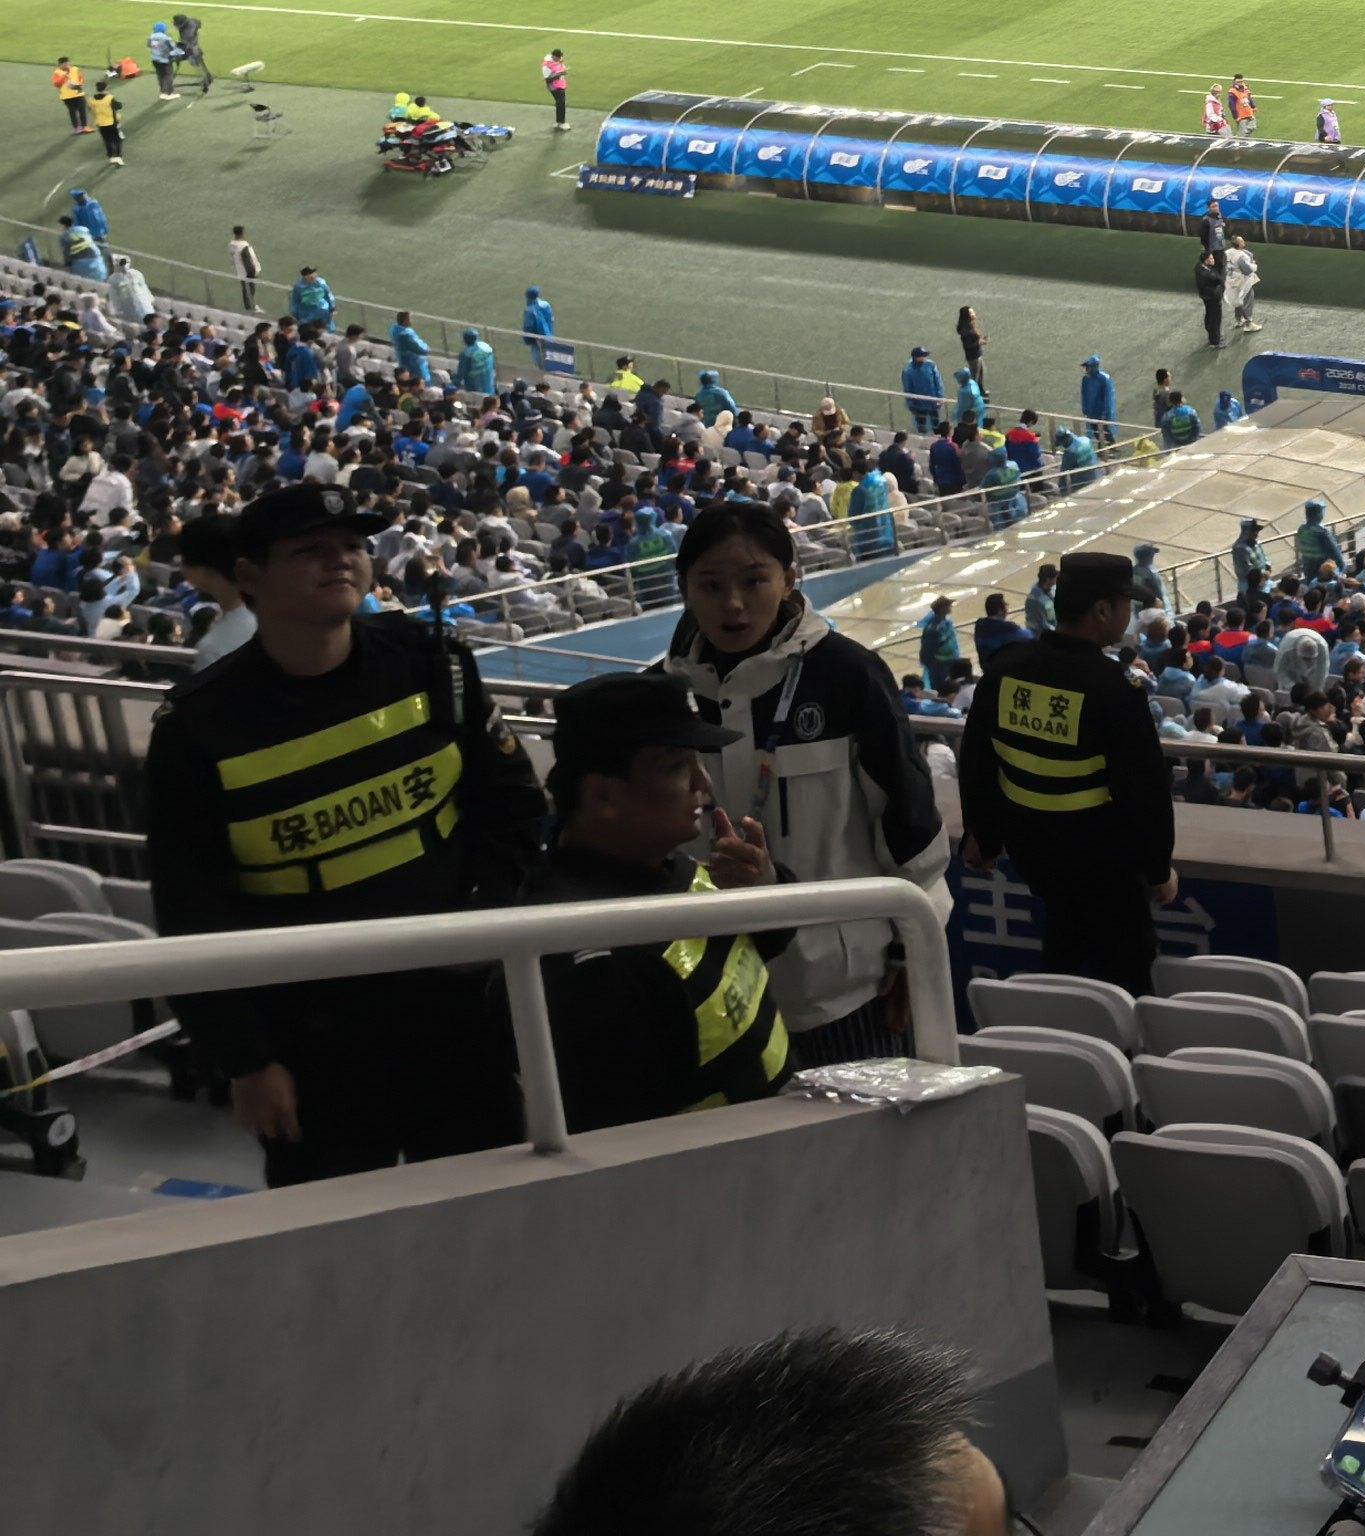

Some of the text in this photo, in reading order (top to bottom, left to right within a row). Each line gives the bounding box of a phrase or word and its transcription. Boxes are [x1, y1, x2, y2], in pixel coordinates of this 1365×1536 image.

[1326, 368, 1354, 380] 2026
[1012, 685, 1071, 722] 保安
[1008, 710, 1070, 739] BAOAN
